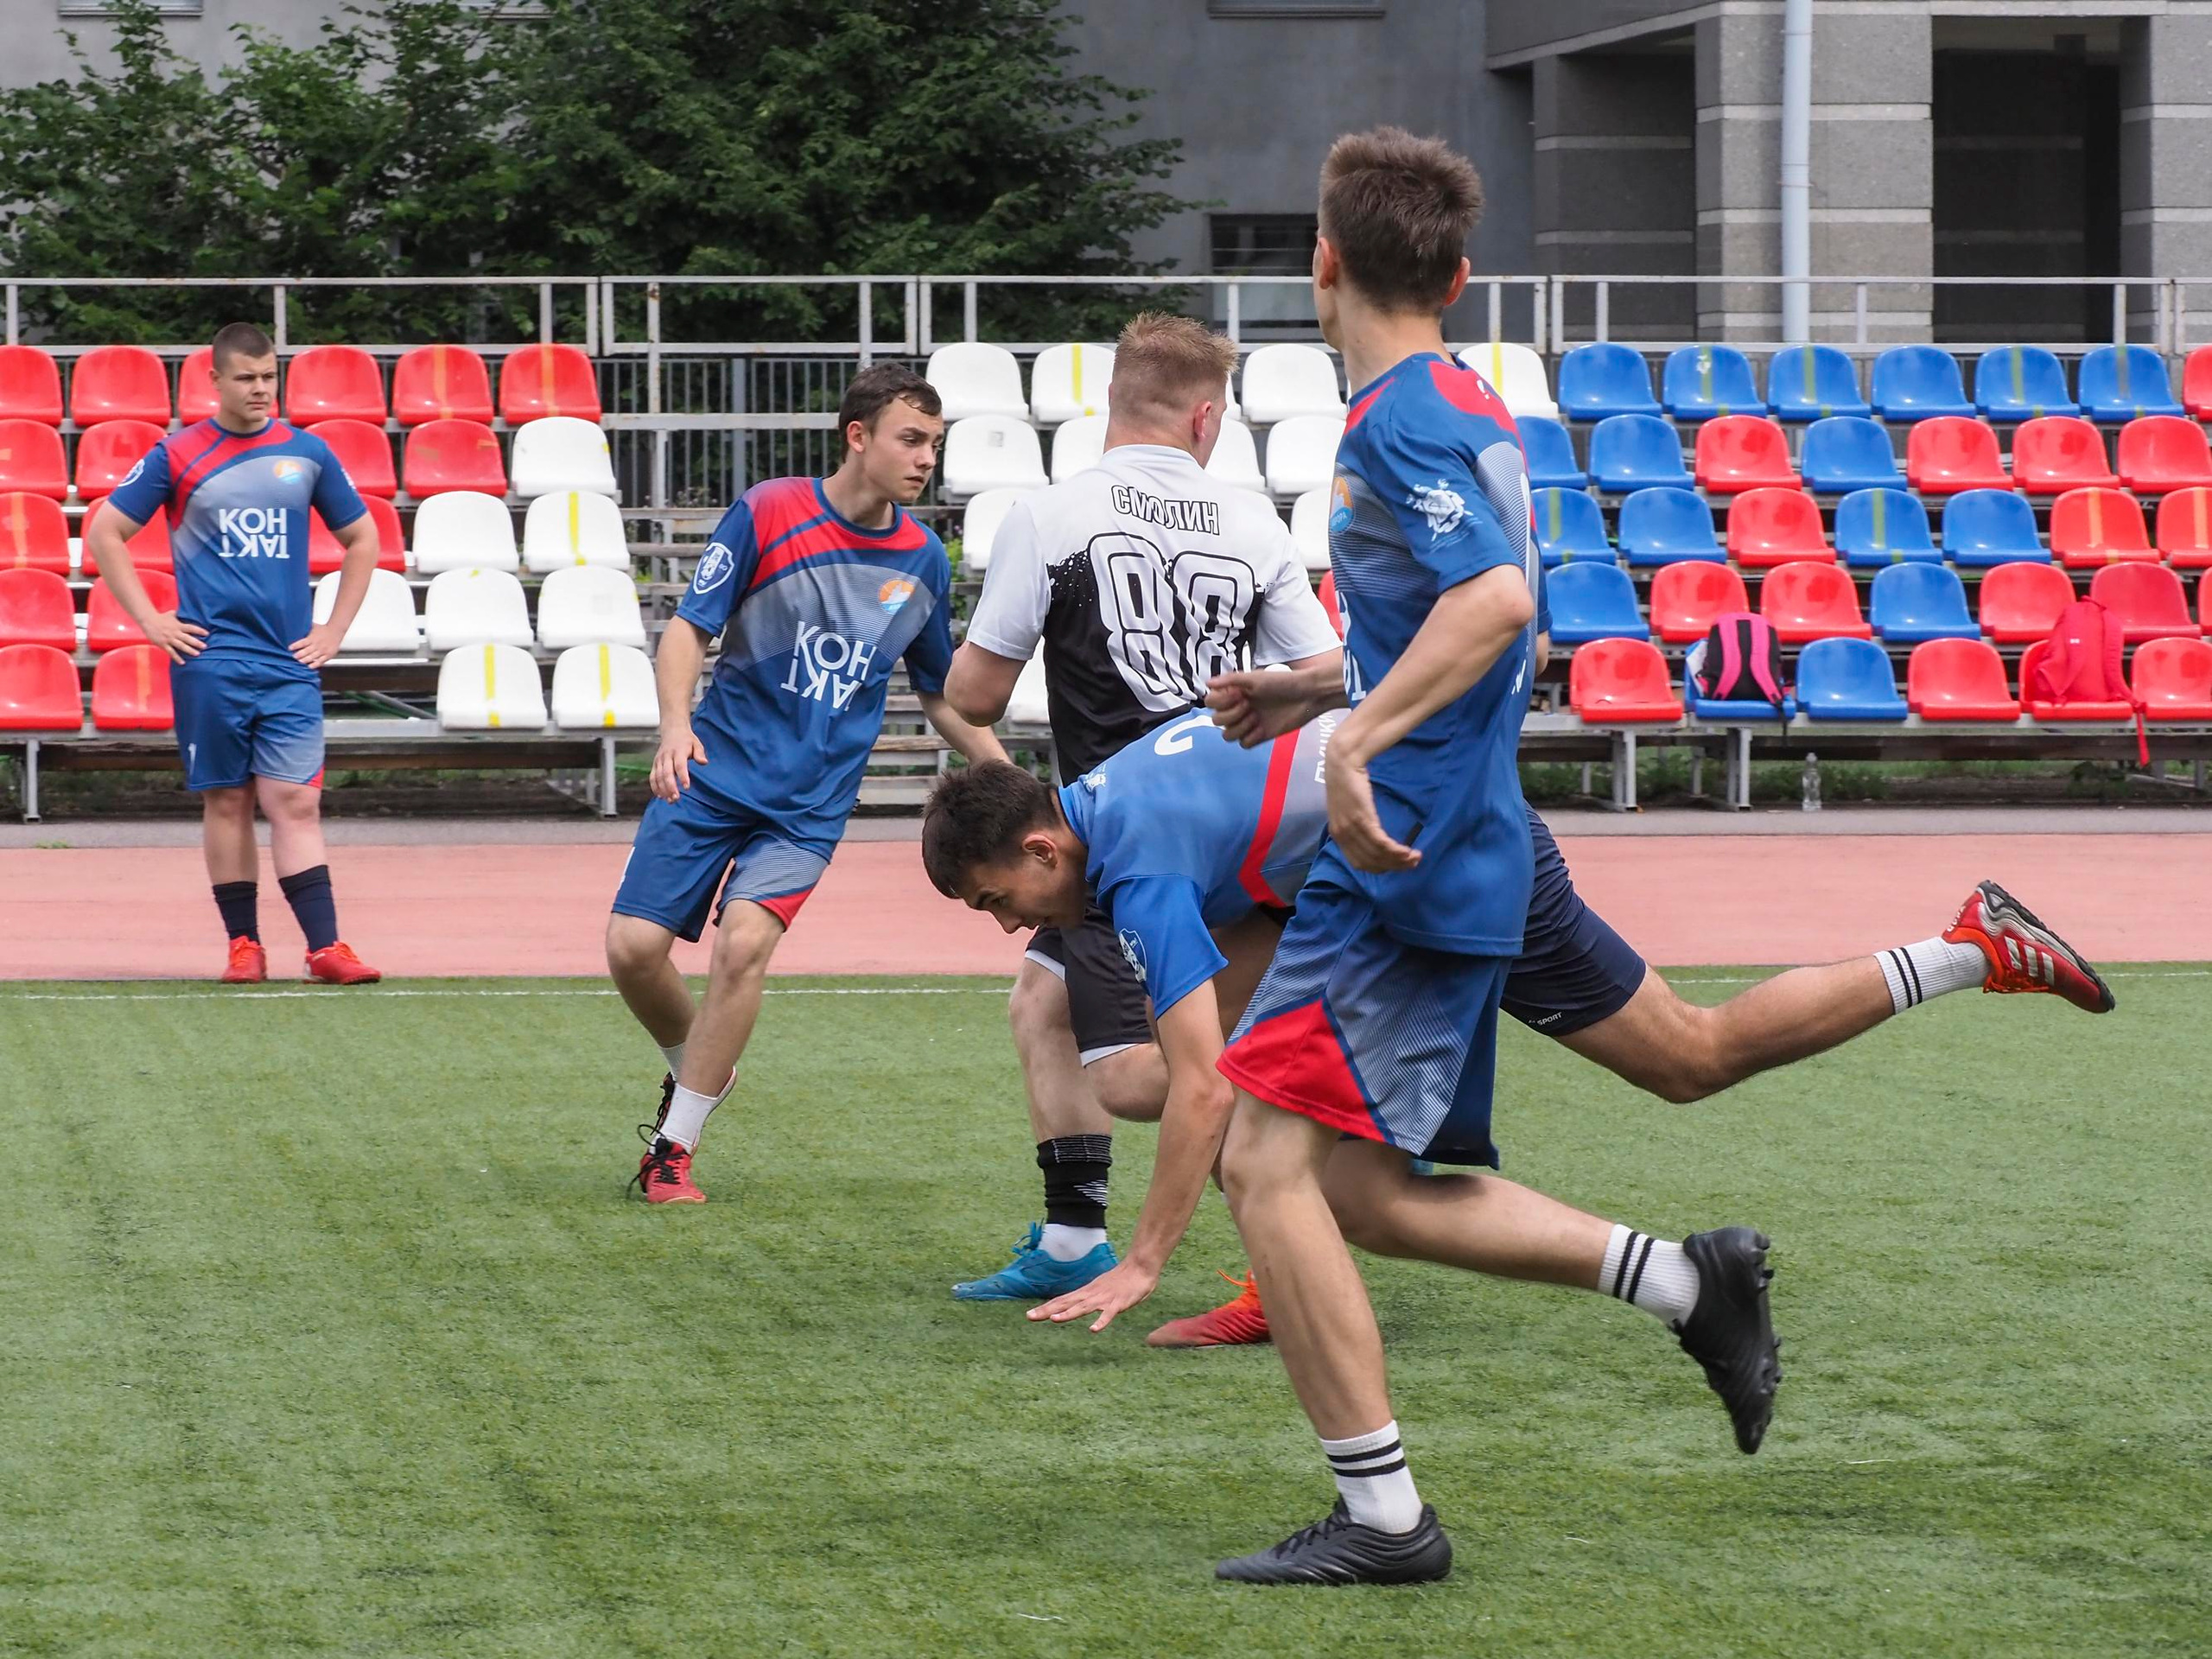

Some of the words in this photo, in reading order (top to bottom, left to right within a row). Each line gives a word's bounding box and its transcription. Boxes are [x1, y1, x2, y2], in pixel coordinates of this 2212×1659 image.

[1111, 485, 1221, 536] СМОЛИН
[1087, 531, 1256, 713] 88
[1537, 1011, 1562, 1027] SPORT
